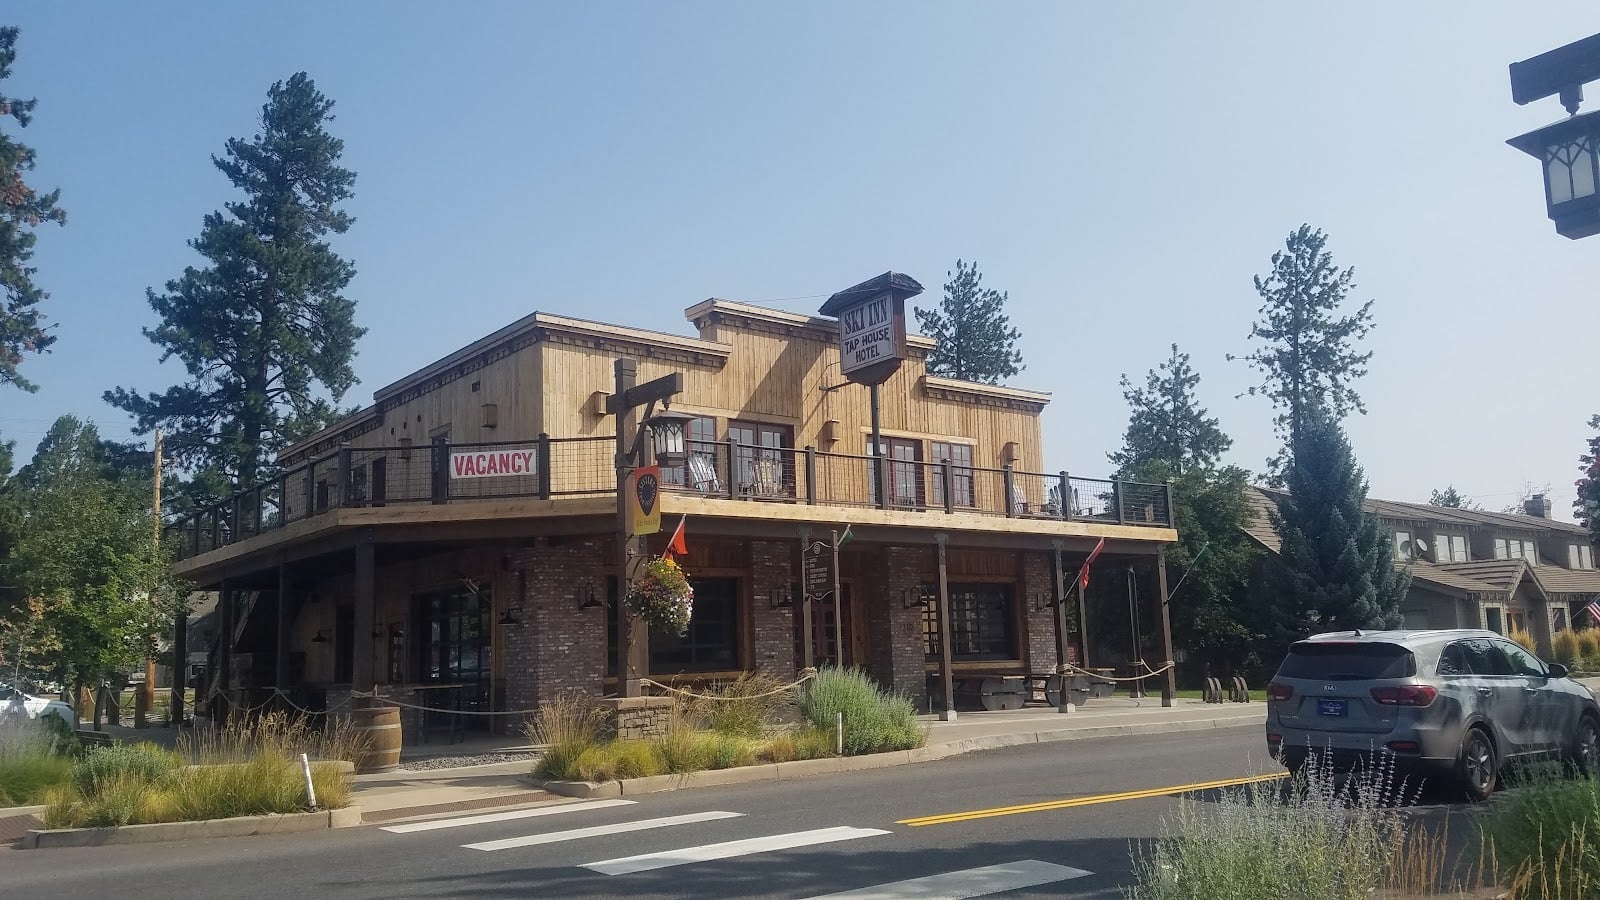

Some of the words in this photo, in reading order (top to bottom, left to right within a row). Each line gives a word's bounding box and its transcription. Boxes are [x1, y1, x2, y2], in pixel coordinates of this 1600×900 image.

[845, 307, 865, 335] SKI
[868, 299, 888, 327] INN
[845, 338, 860, 355] TAP
[862, 327, 890, 346] HOUSE
[855, 345, 880, 363] HOTEL
[453, 452, 533, 476] VACANCY
